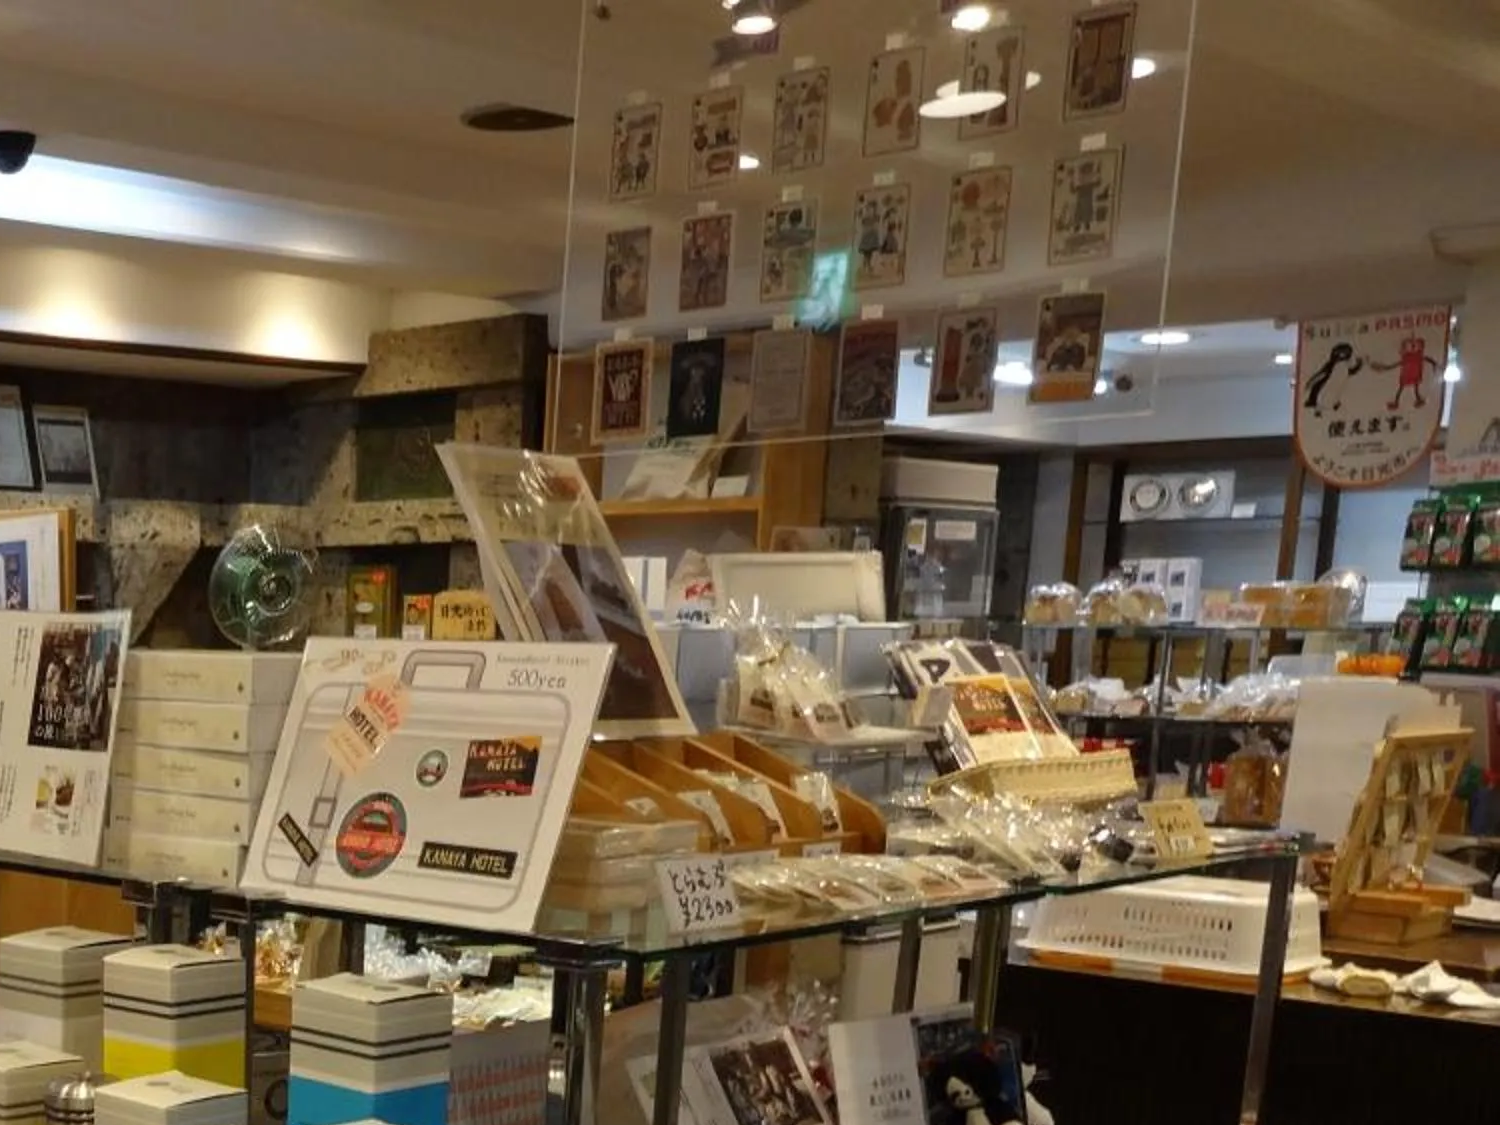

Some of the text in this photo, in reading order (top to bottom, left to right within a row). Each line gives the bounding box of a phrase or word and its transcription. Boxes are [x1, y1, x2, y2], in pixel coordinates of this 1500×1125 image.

[1374, 311, 1447, 332] PASMO
[422, 848, 509, 874] KANAYA HOTEL
